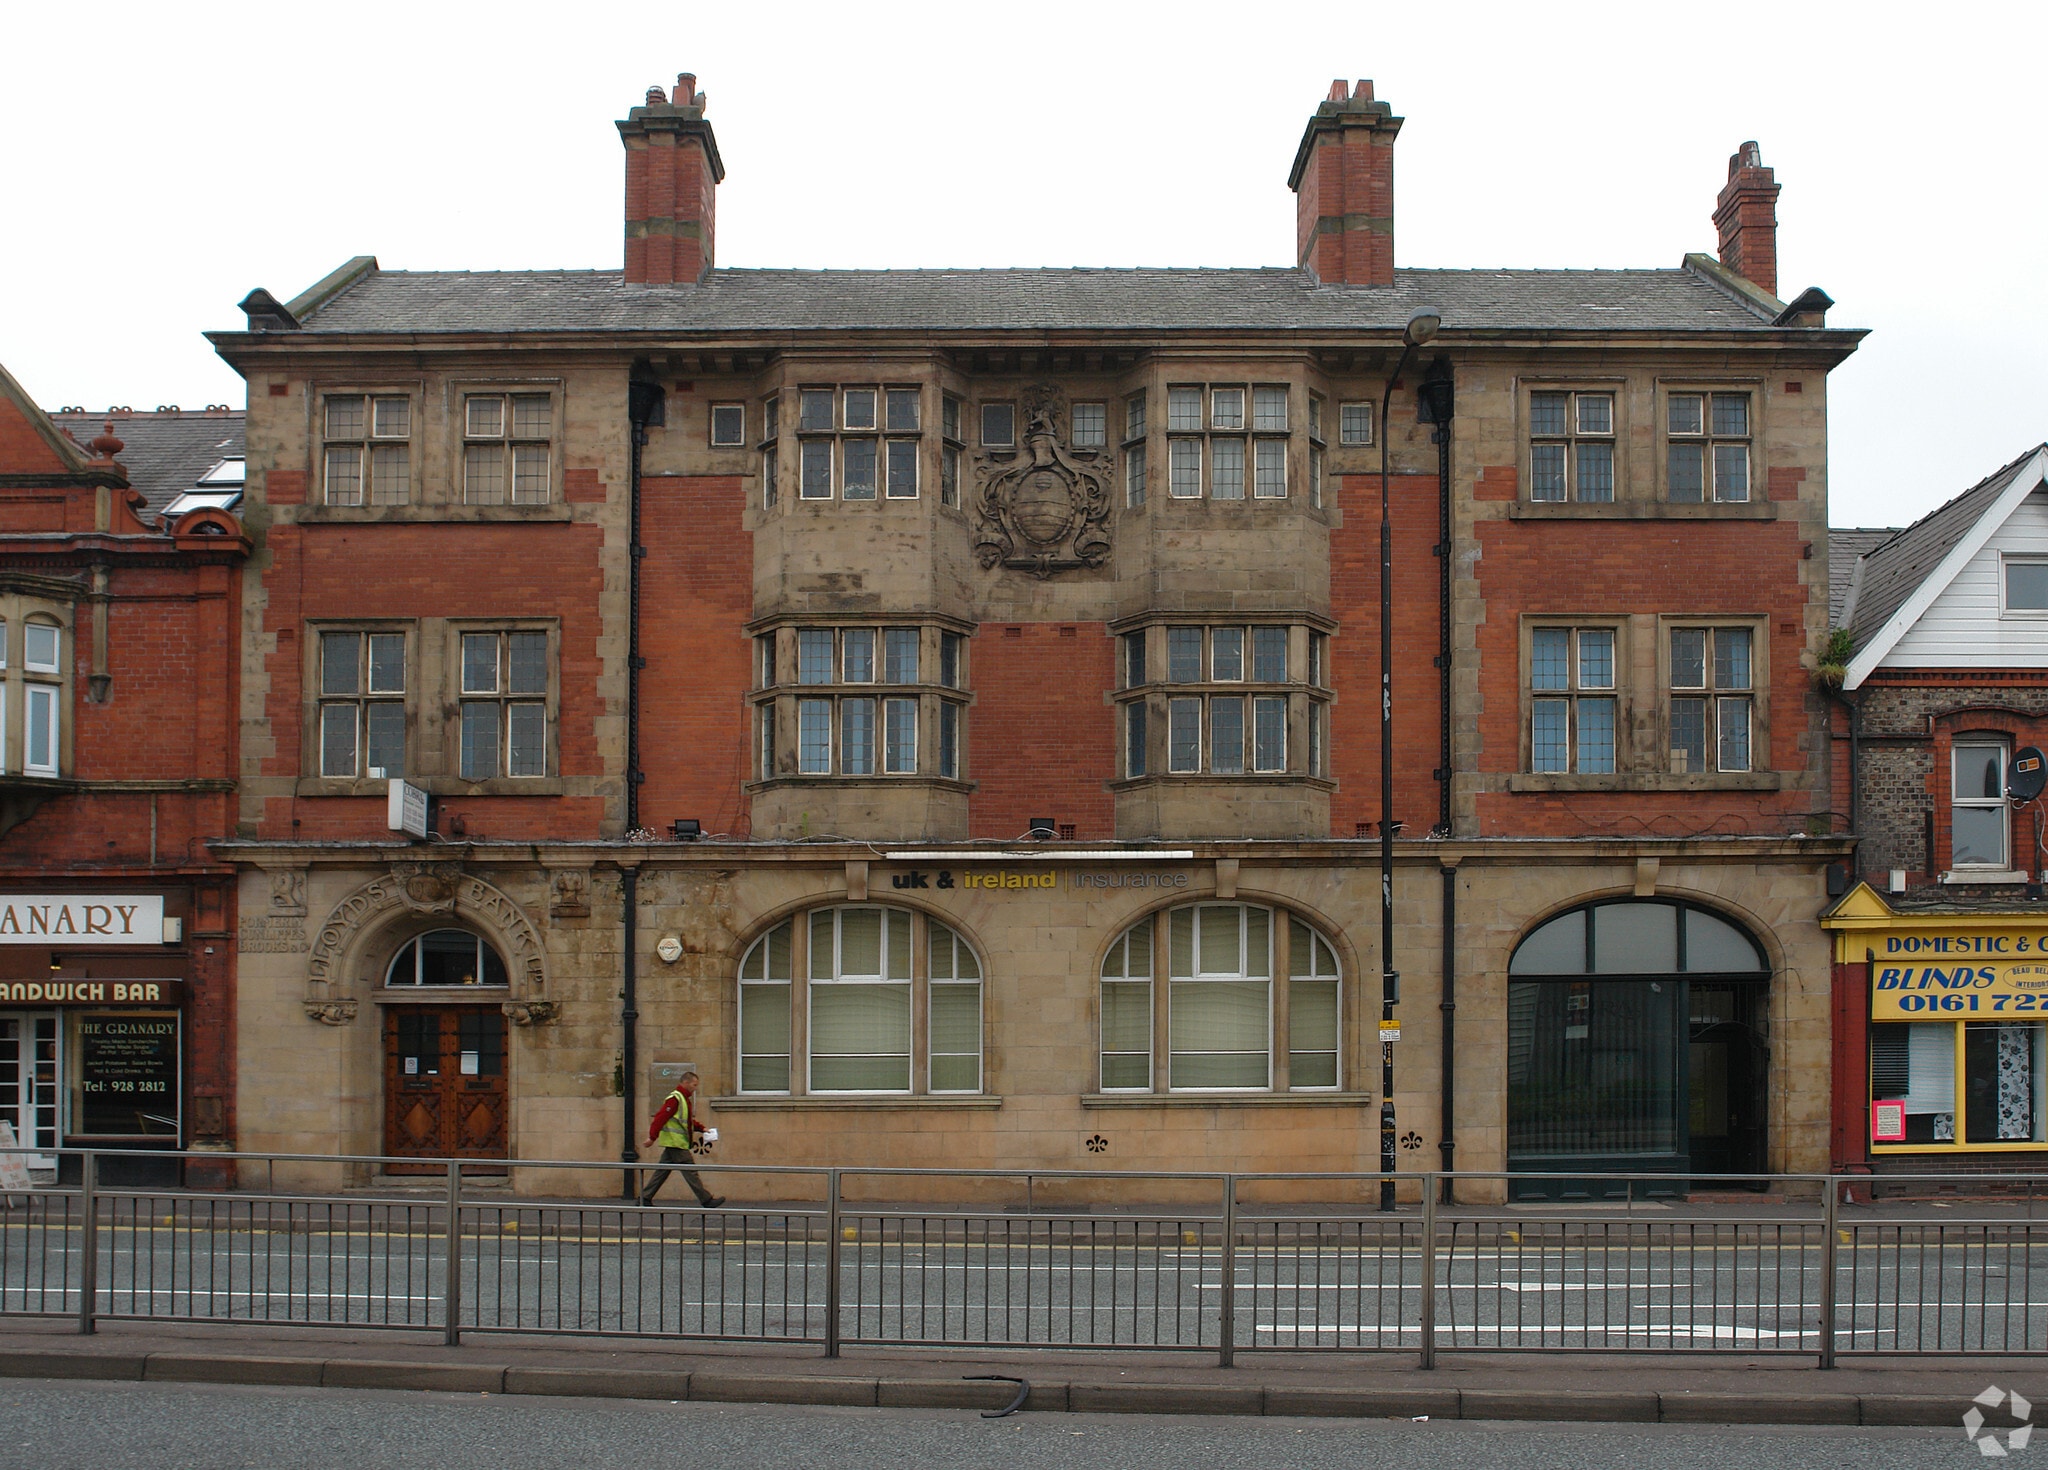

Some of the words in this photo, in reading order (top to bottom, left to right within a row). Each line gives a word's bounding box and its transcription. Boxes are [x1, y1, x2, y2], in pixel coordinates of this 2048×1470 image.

[892, 870, 929, 889] uk
[936, 870, 955, 889] &
[963, 870, 1056, 889] ireland
[1075, 870, 1188, 889] insurance
[0, 904, 138, 935] ANARY
[308, 883, 386, 984] LLOYDS
[470, 883, 538, 953] BANK
[238, 940, 288, 953] BROOKS
[1886, 936, 2010, 953] DOMESTIC
[2016, 936, 2031, 953] &
[1876, 967, 1996, 990] BLINDS
[0, 983, 104, 1001] ANDWICH
[113, 983, 160, 1001] BAR
[1899, 994, 1979, 1011] 0161
[77, 1023, 102, 1034] THE
[105, 1023, 175, 1034] GRANARY
[83, 1081, 107, 1092] Tel:
[111, 1081, 134, 1092] 928
[138, 1081, 166, 1092] 2812
